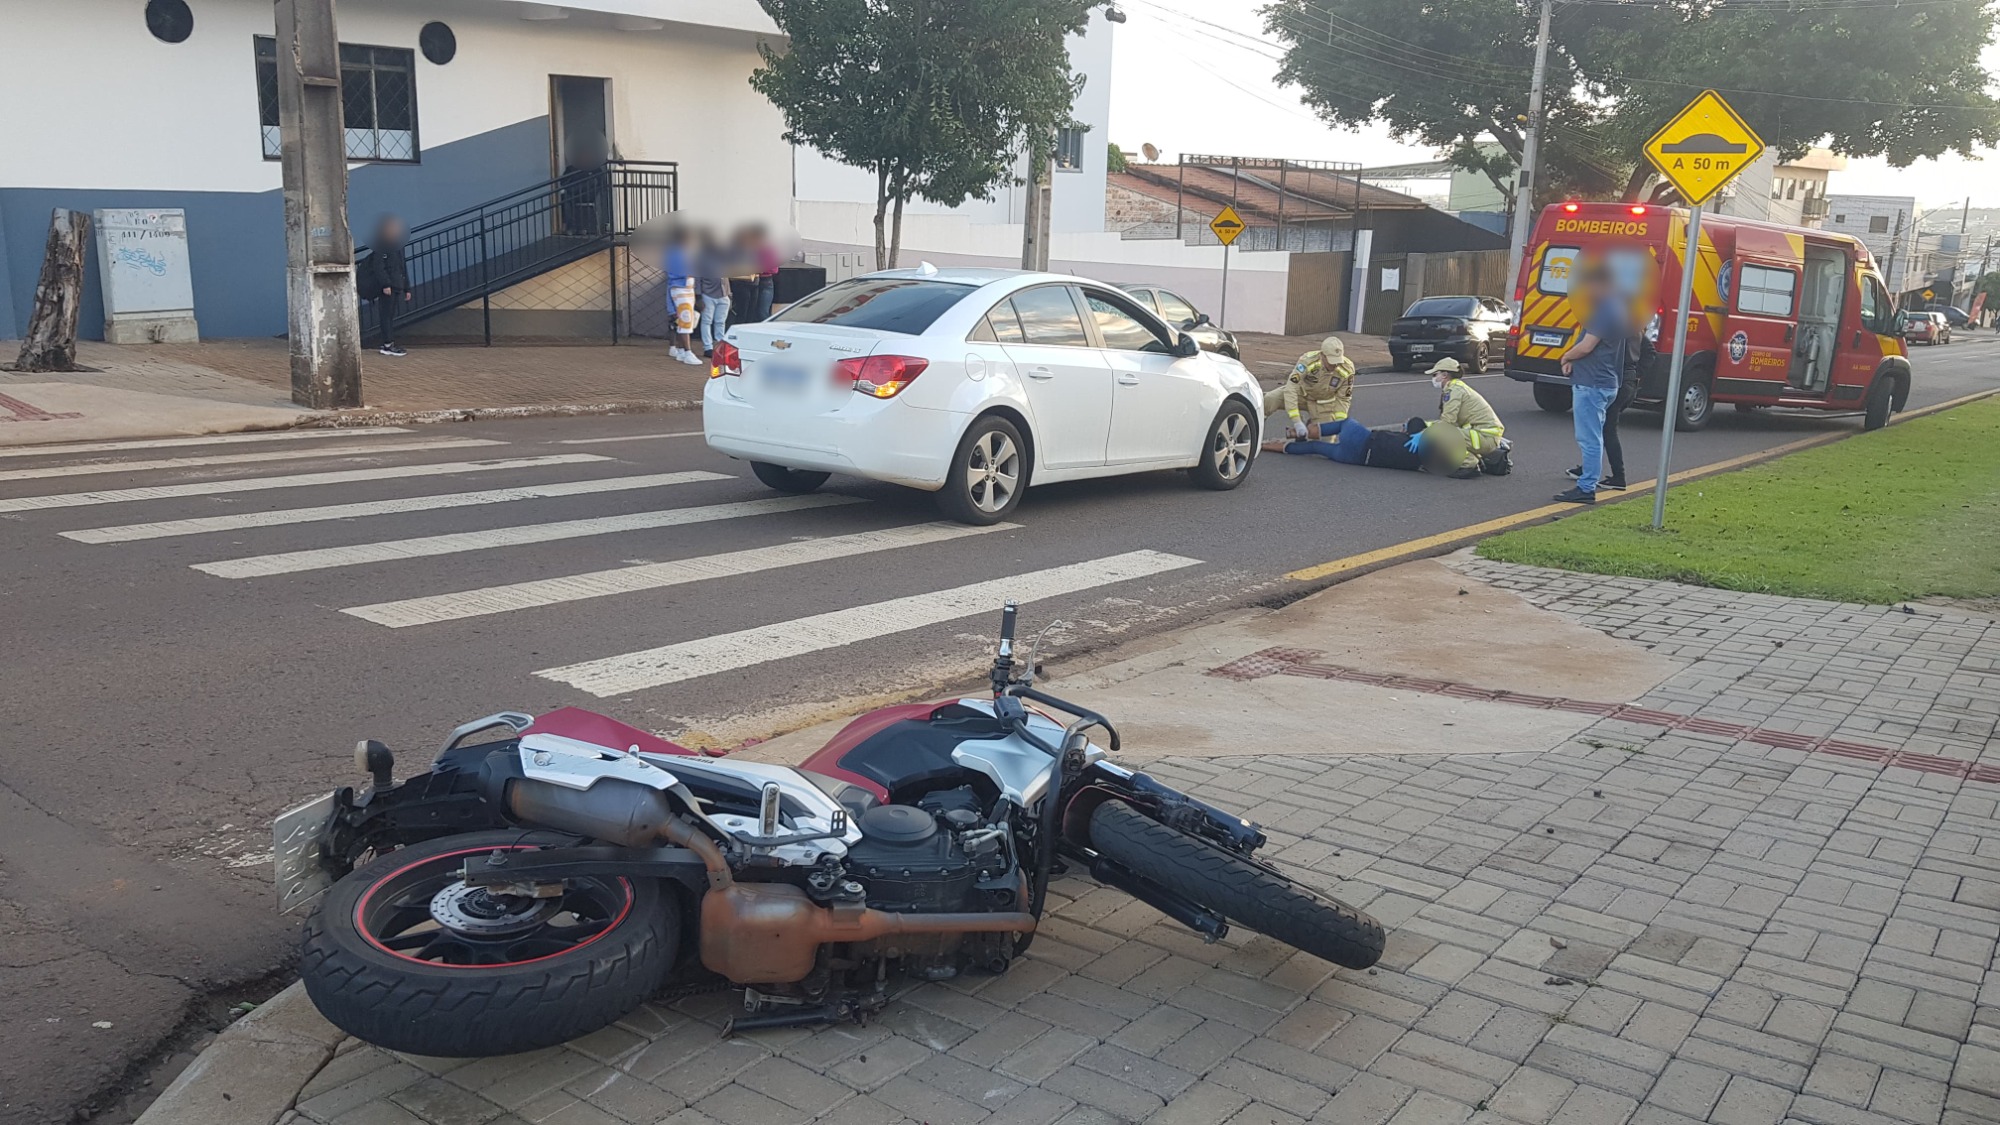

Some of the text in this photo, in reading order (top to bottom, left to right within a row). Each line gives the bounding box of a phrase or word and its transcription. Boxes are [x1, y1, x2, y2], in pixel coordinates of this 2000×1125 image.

[1672, 157, 1730, 170] A 50 m
[1555, 219, 1648, 235] BOMBEIROS
[1550, 267, 1570, 279] 193
[1750, 356, 1785, 367] BOMBEIROS
